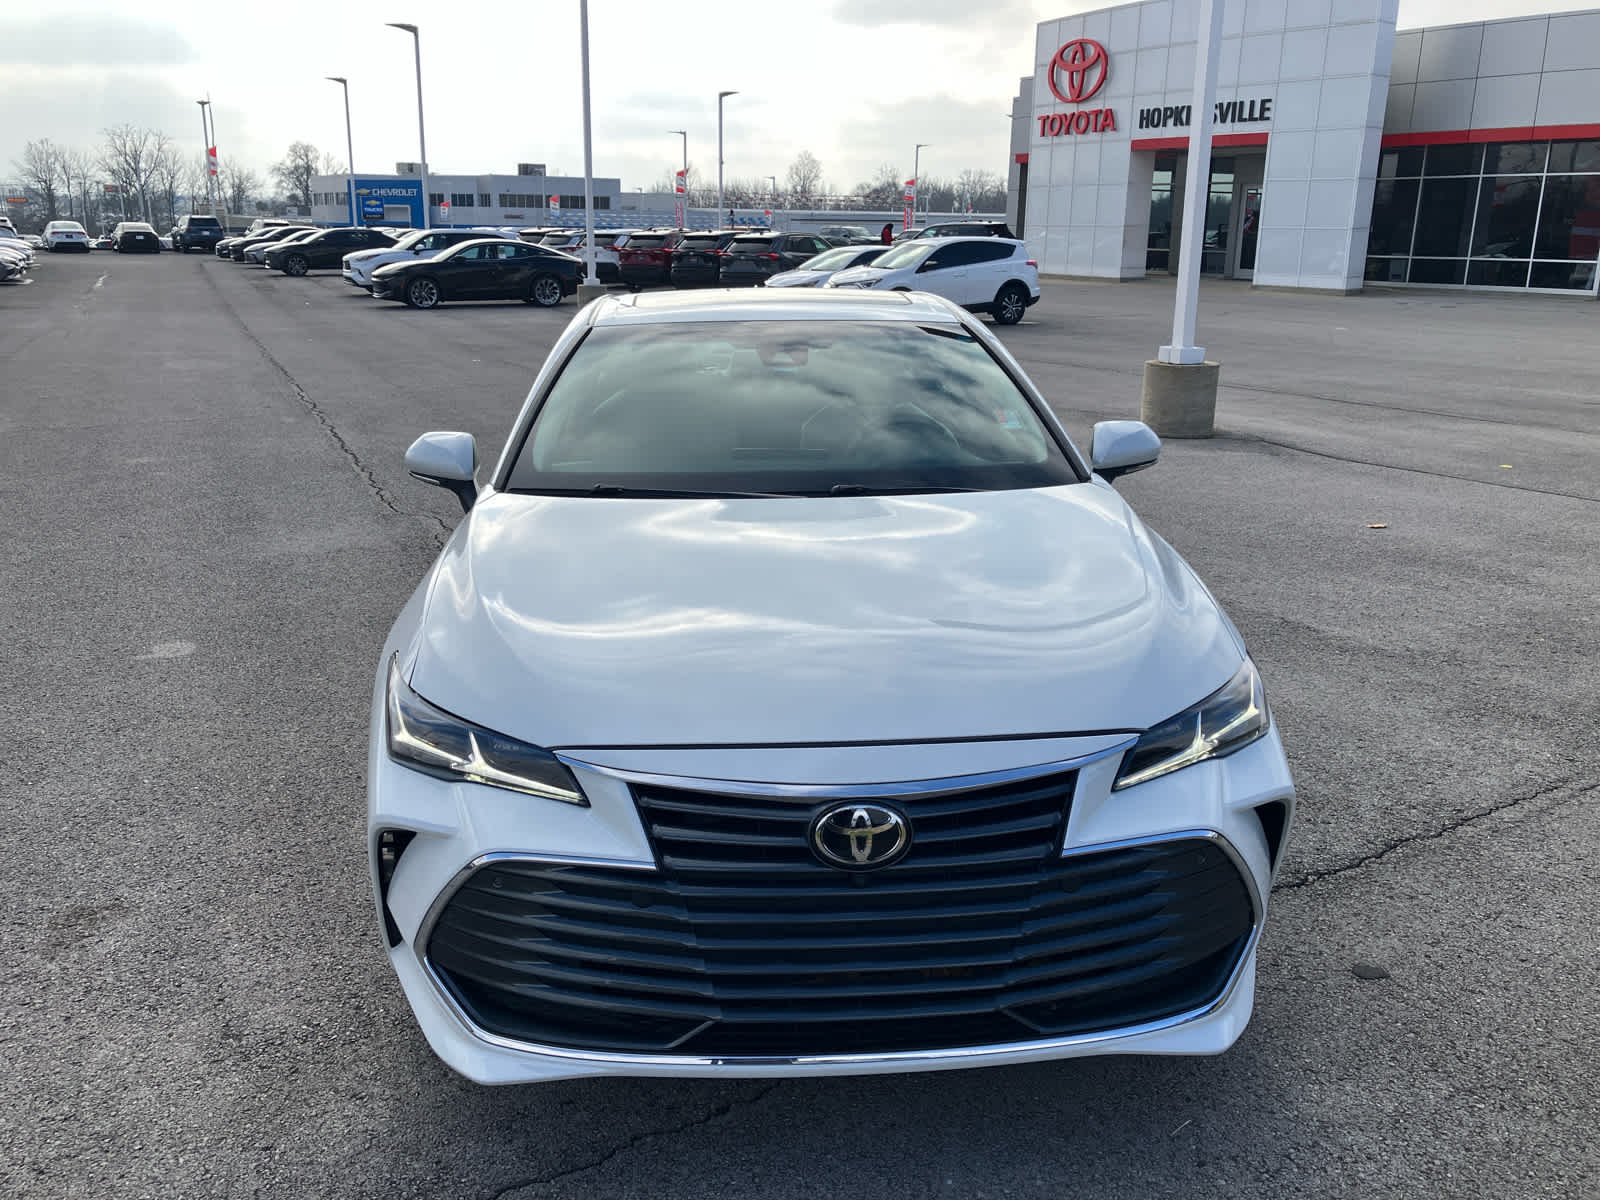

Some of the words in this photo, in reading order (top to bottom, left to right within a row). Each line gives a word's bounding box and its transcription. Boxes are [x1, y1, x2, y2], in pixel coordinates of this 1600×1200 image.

[1037, 107, 1117, 138] TOYOTA
[1139, 98, 1272, 129] HOPKIVILLE
[372, 188, 417, 197] CHEVROLET
